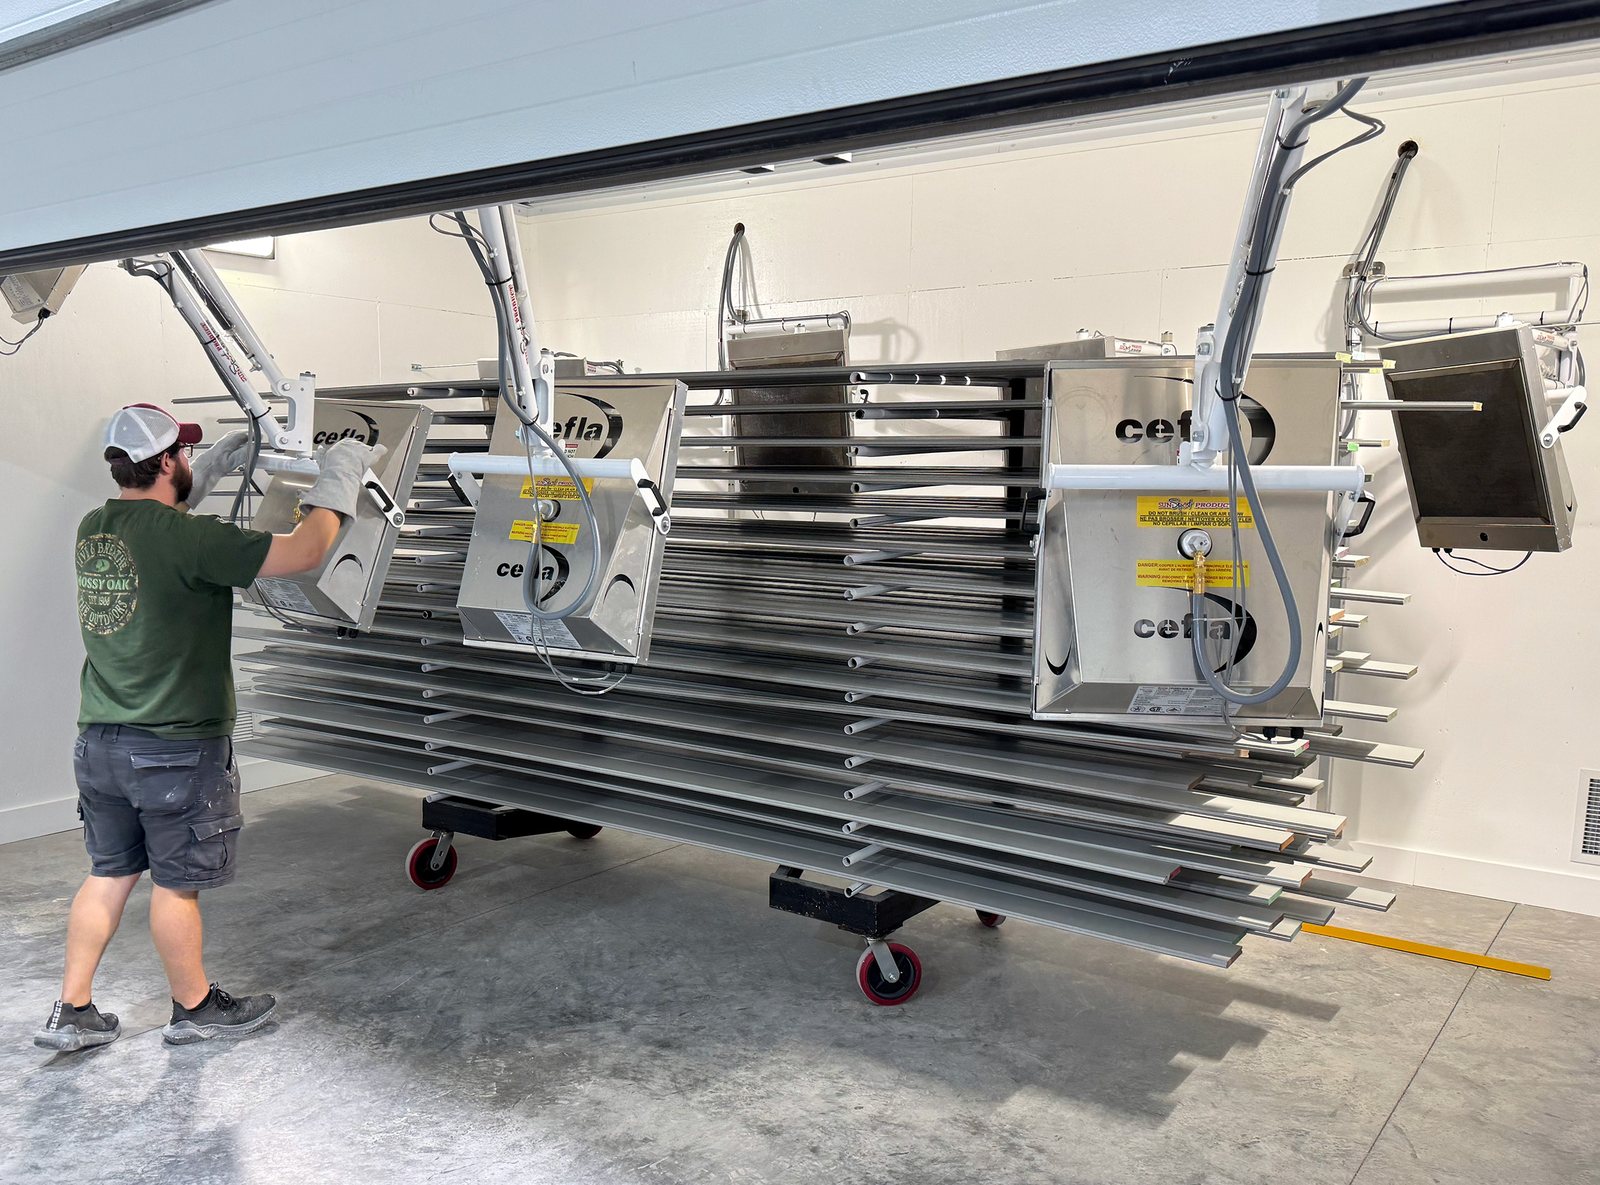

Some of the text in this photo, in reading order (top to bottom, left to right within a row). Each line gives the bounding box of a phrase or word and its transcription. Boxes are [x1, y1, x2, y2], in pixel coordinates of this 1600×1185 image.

[553, 416, 604, 441] efla
[1115, 410, 1192, 444] cef
[106, 579, 130, 591] OAK
